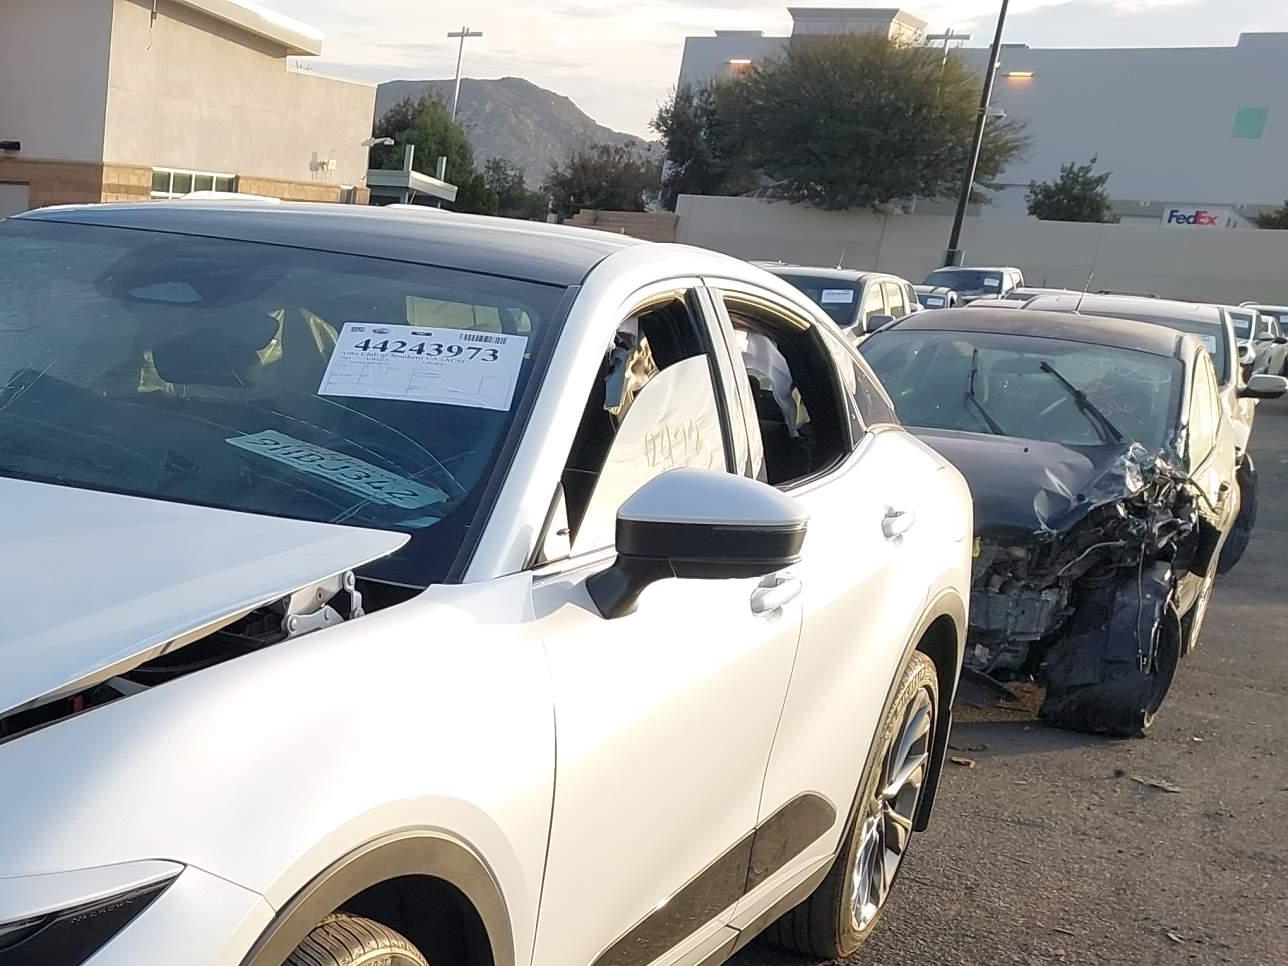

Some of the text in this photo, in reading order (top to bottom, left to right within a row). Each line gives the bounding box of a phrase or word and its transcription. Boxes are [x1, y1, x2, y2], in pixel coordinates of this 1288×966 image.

[1167, 209, 1219, 225] FedEx
[354, 338, 499, 362] 44243973
[248, 438, 420, 501] 9HBJ342
